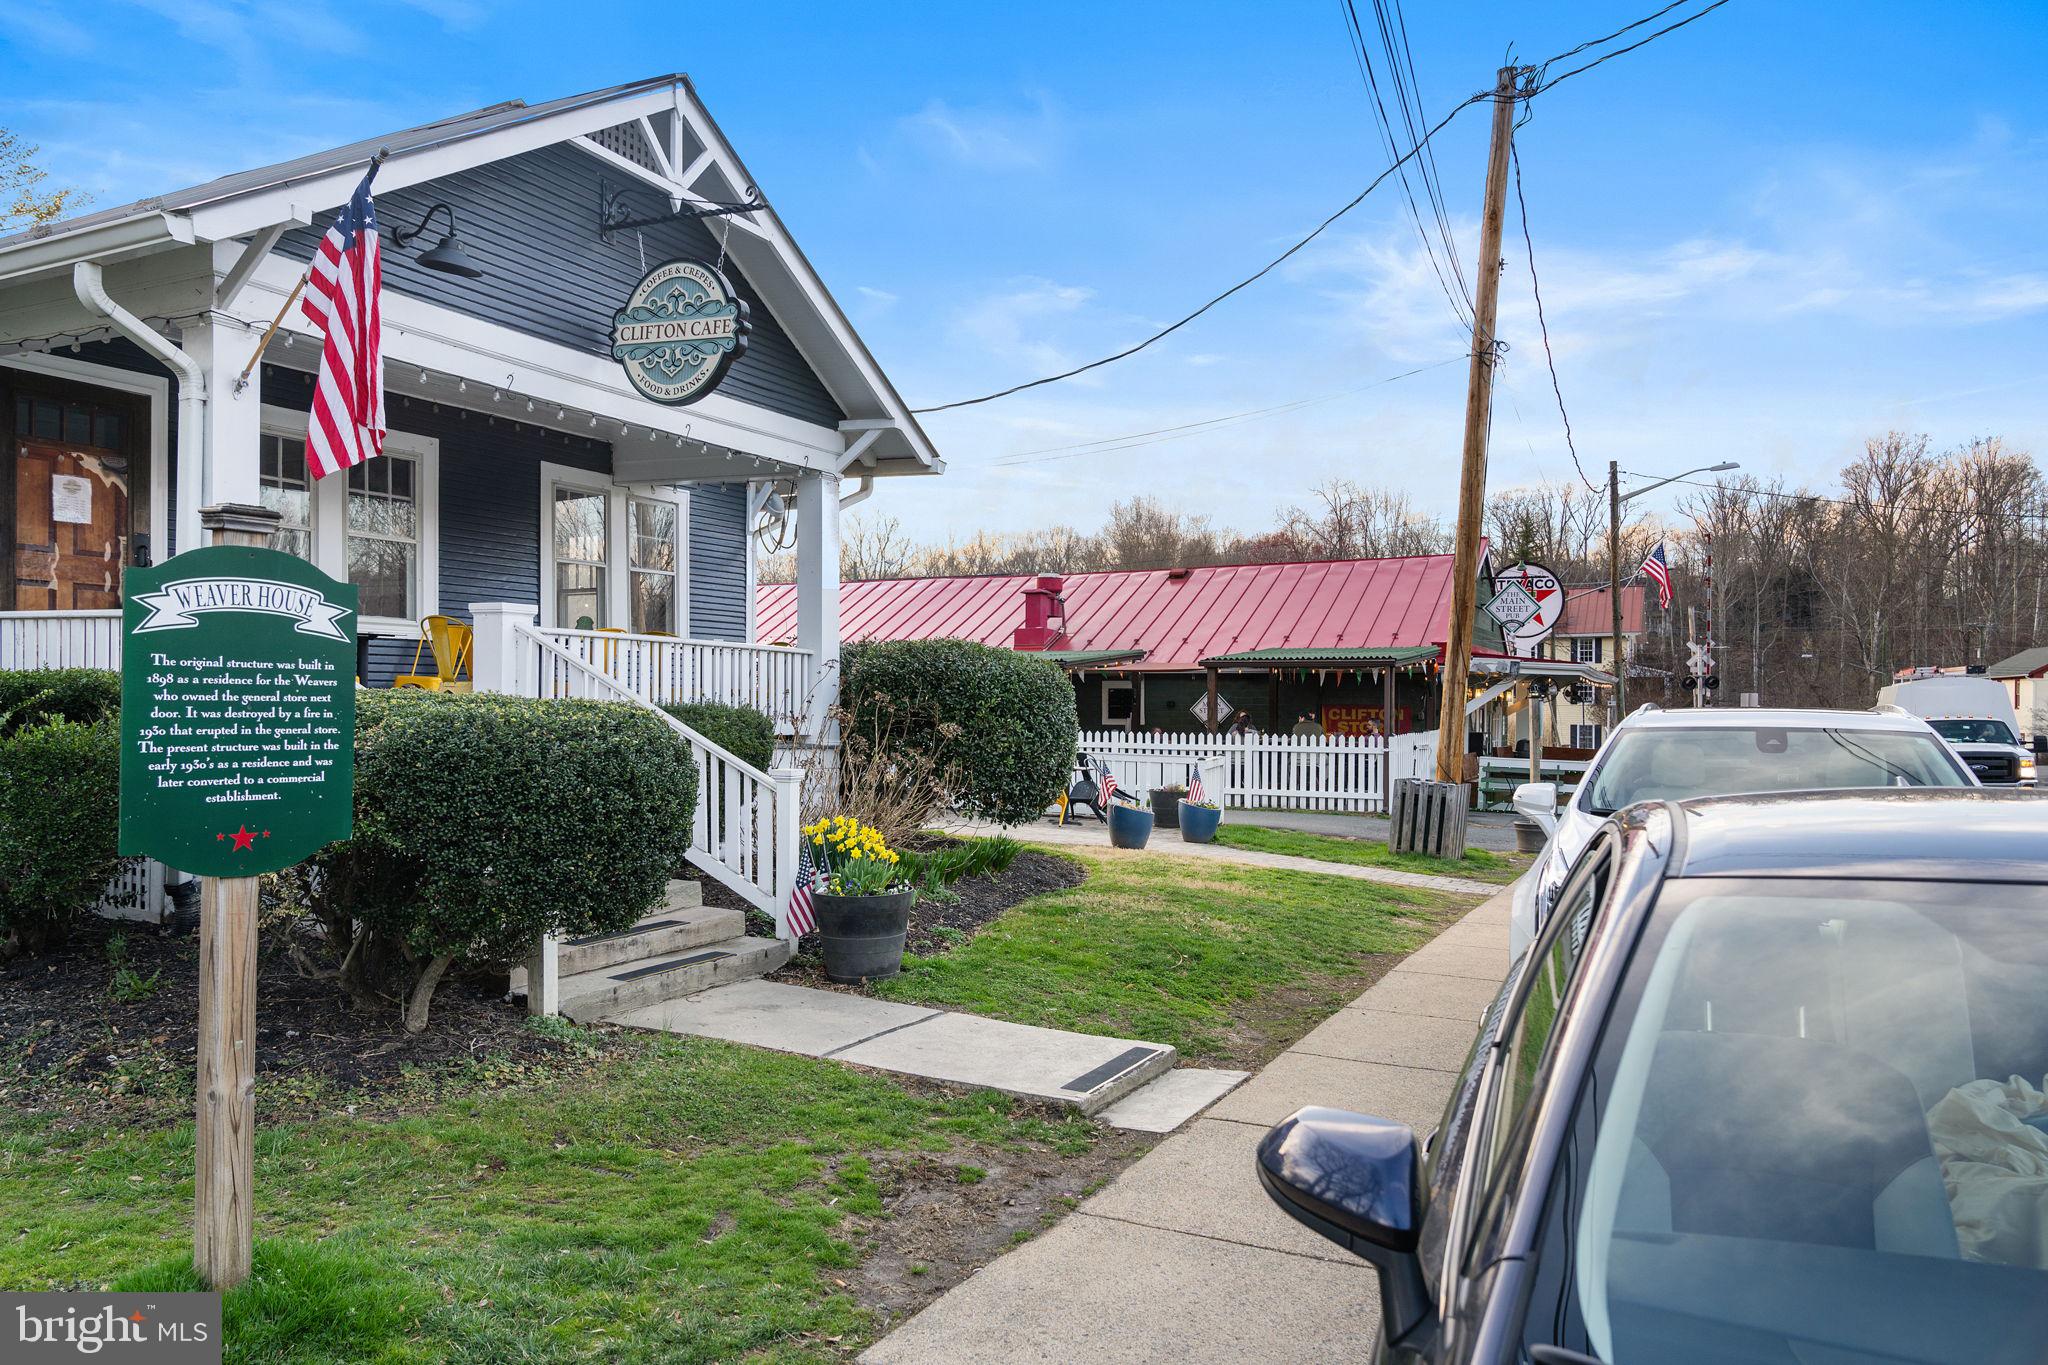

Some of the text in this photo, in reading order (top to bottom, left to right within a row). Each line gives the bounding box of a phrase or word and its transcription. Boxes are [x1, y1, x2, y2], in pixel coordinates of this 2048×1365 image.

[641, 266, 713, 294] COFFEE & CREPES
[620, 318, 732, 342] CLIFTON CAFE
[640, 369, 706, 396] FOOD & DRINKS
[172, 584, 316, 618] WEAVER HOUSE
[151, 654, 176, 666] The
[180, 656, 223, 670] original
[227, 660, 273, 668] structure
[299, 659, 321, 670] built
[325, 662, 334, 670] in
[148, 673, 173, 687] 1898
[203, 673, 252, 684] residence
[256, 674, 271, 685] for
[275, 674, 290, 685] the
[294, 675, 337, 686] Weavers
[154, 689, 178, 700] who
[182, 690, 218, 701] owned
[222, 690, 239, 701] the
[242, 691, 280, 705] general
[151, 706, 180, 718] door.
[186, 706, 197, 717] It
[225, 707, 275, 721] destroyed
[279, 707, 291, 721] by
[304, 707, 320, 718] fire
[323, 709, 333, 717] in
[140, 726, 166, 739] 1930
[170, 724, 192, 735] that
[196, 723, 237, 738] erupted
[241, 726, 251, 734] in
[255, 723, 271, 734] the
[274, 723, 311, 740] general
[138, 741, 163, 753] The
[167, 744, 209, 758] present
[284, 739, 307, 750] built
[324, 739, 339, 749] the
[149, 758, 177, 774] early
[181, 757, 214, 773] 1930's
[242, 756, 290, 767] residence
[293, 755, 311, 766] and
[158, 776, 184, 787] later
[186, 772, 240, 786] converted
[267, 771, 324, 783] commercial
[206, 790, 281, 802] establishment.
